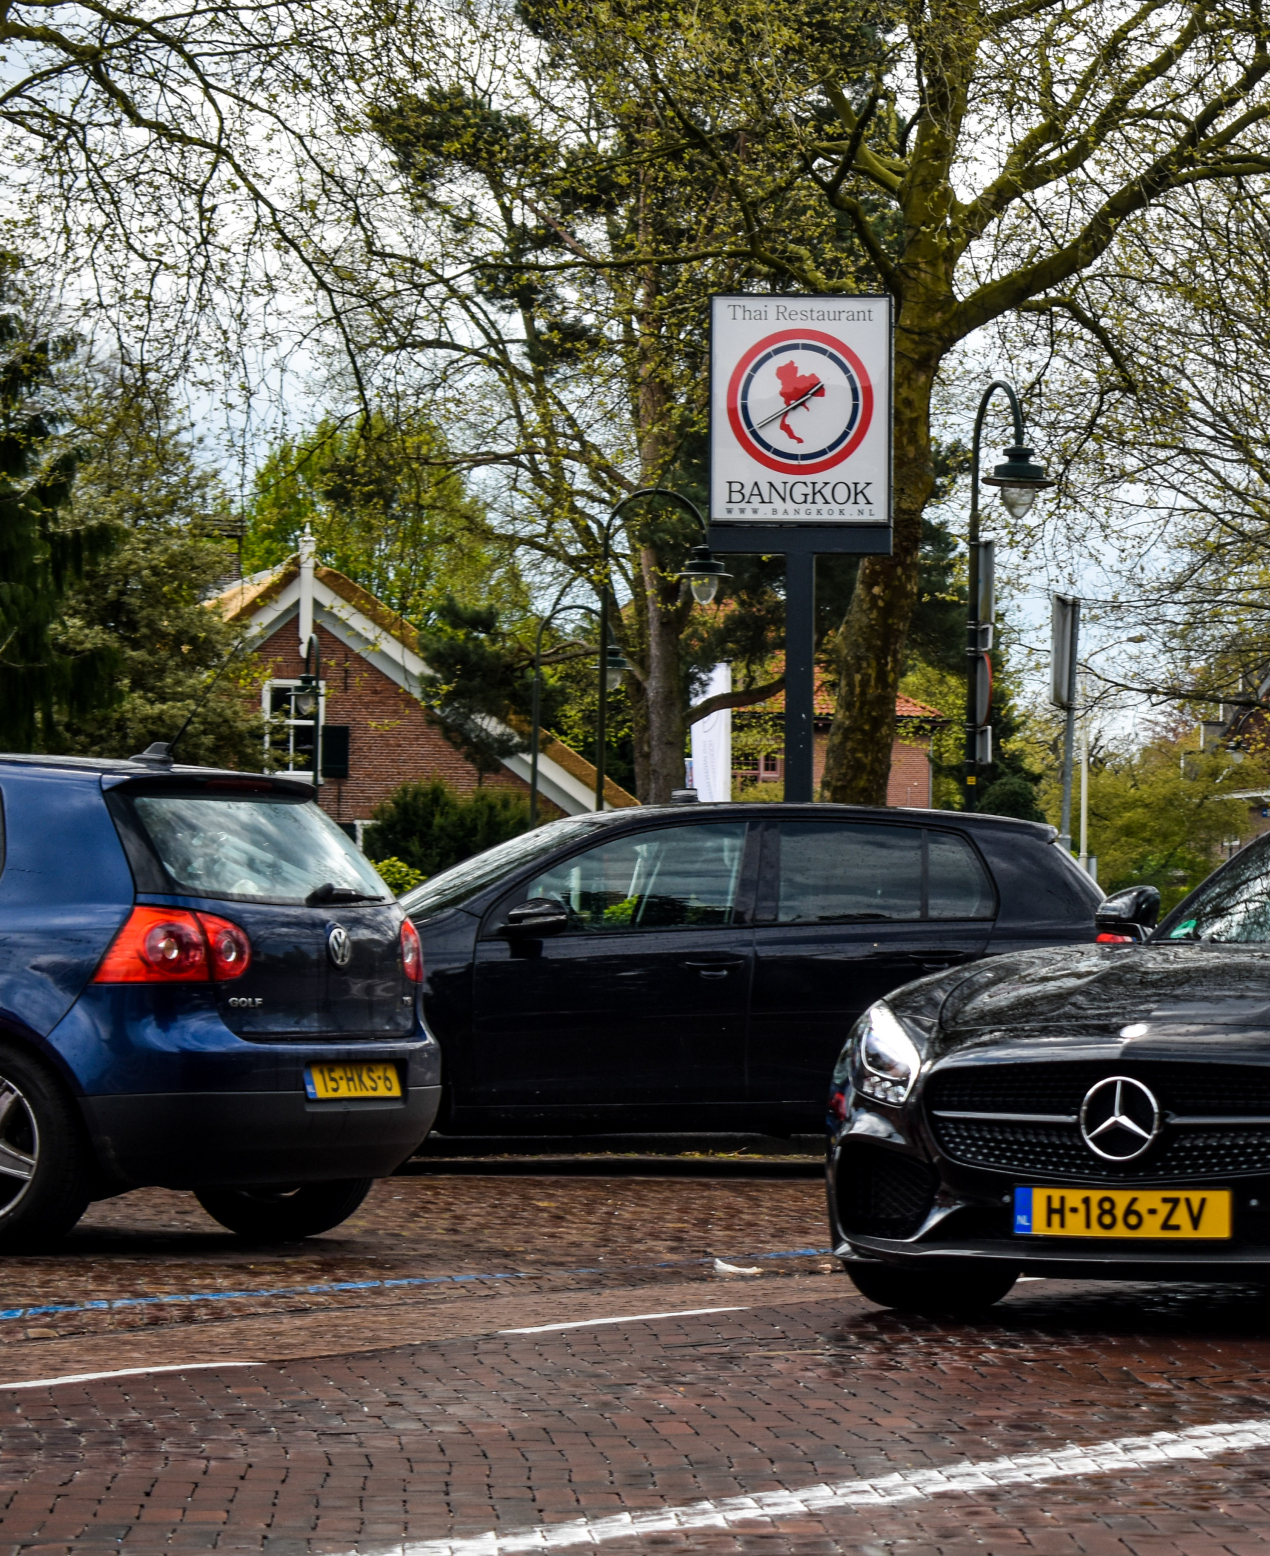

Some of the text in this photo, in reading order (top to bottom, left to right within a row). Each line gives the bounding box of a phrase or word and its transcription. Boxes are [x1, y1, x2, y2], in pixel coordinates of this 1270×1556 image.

[727, 304, 874, 322] Thai Restaurant
[725, 480, 874, 505] BANGKOK
[725, 507, 876, 517] WWW.BANGKOK.NL
[228, 997, 263, 1008] GOLF
[318, 1066, 393, 1093] 15-HKS-6
[1016, 1215, 1031, 1226] NL
[1045, 1195, 1207, 1231] H-186-ZV
